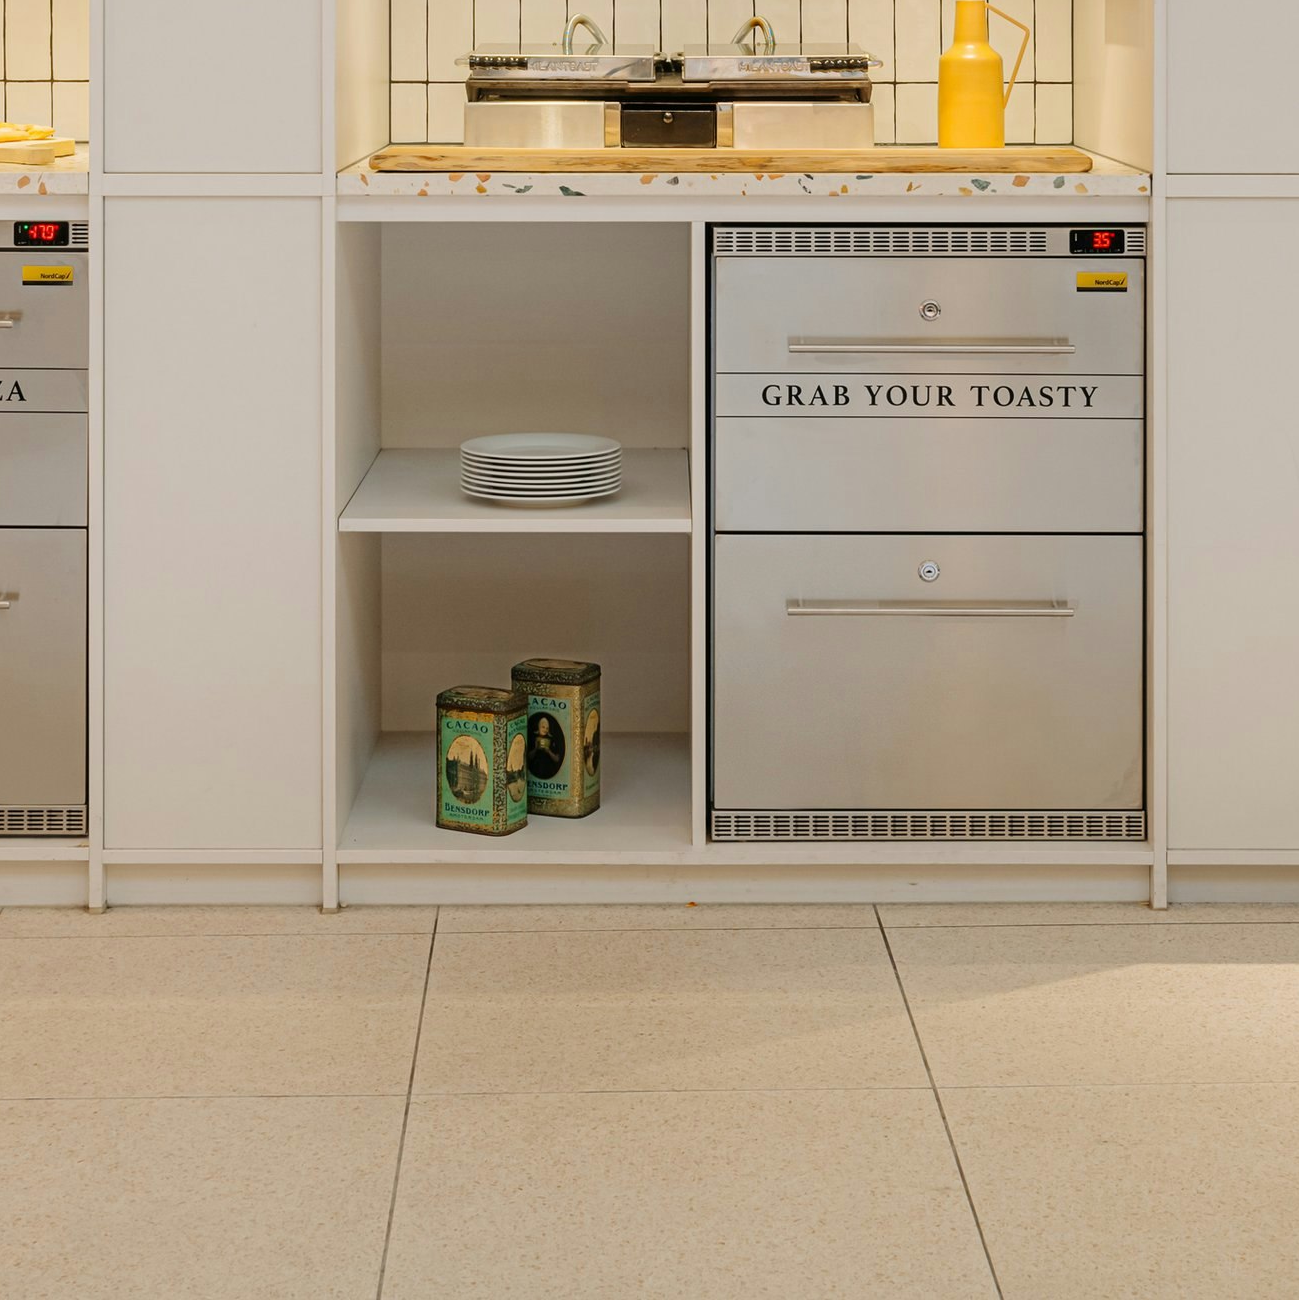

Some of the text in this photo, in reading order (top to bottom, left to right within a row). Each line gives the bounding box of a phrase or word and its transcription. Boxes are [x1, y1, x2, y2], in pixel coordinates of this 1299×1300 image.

[762, 385, 1098, 407] GRAB YOUR TOASTY
[527, 698, 567, 710] ACAO
[446, 721, 488, 733] CACAO
[527, 781, 568, 791] ENSDORP
